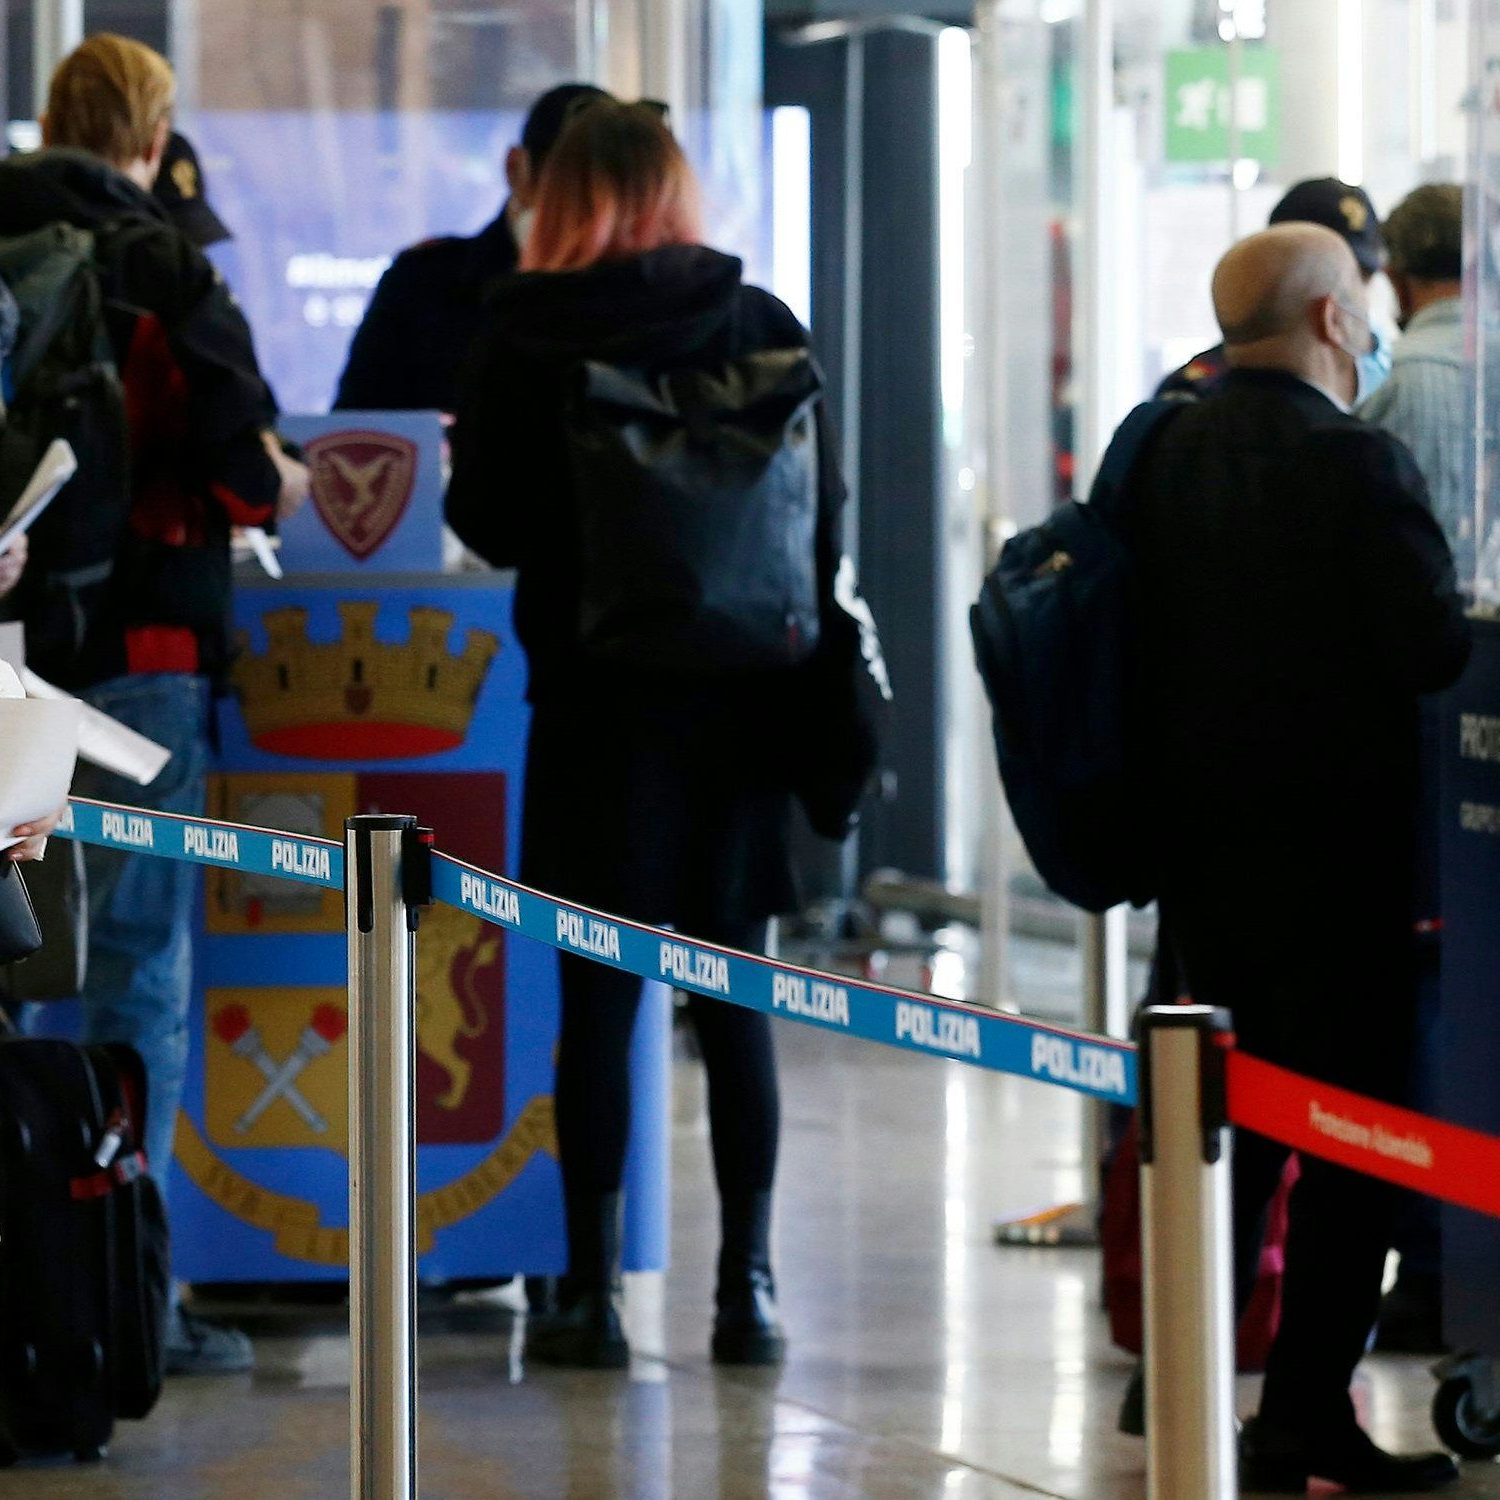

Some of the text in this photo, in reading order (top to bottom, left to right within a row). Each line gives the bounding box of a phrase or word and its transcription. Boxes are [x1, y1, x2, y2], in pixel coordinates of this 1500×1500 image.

[102, 811, 153, 848] POLIZIA
[184, 825, 239, 863] POLIZIA
[271, 839, 330, 880] POLIZIA
[460, 872, 1126, 1095] POLIZIA POLIZIA POLIZIA POLIZIA POLIZIA POLIZIA
